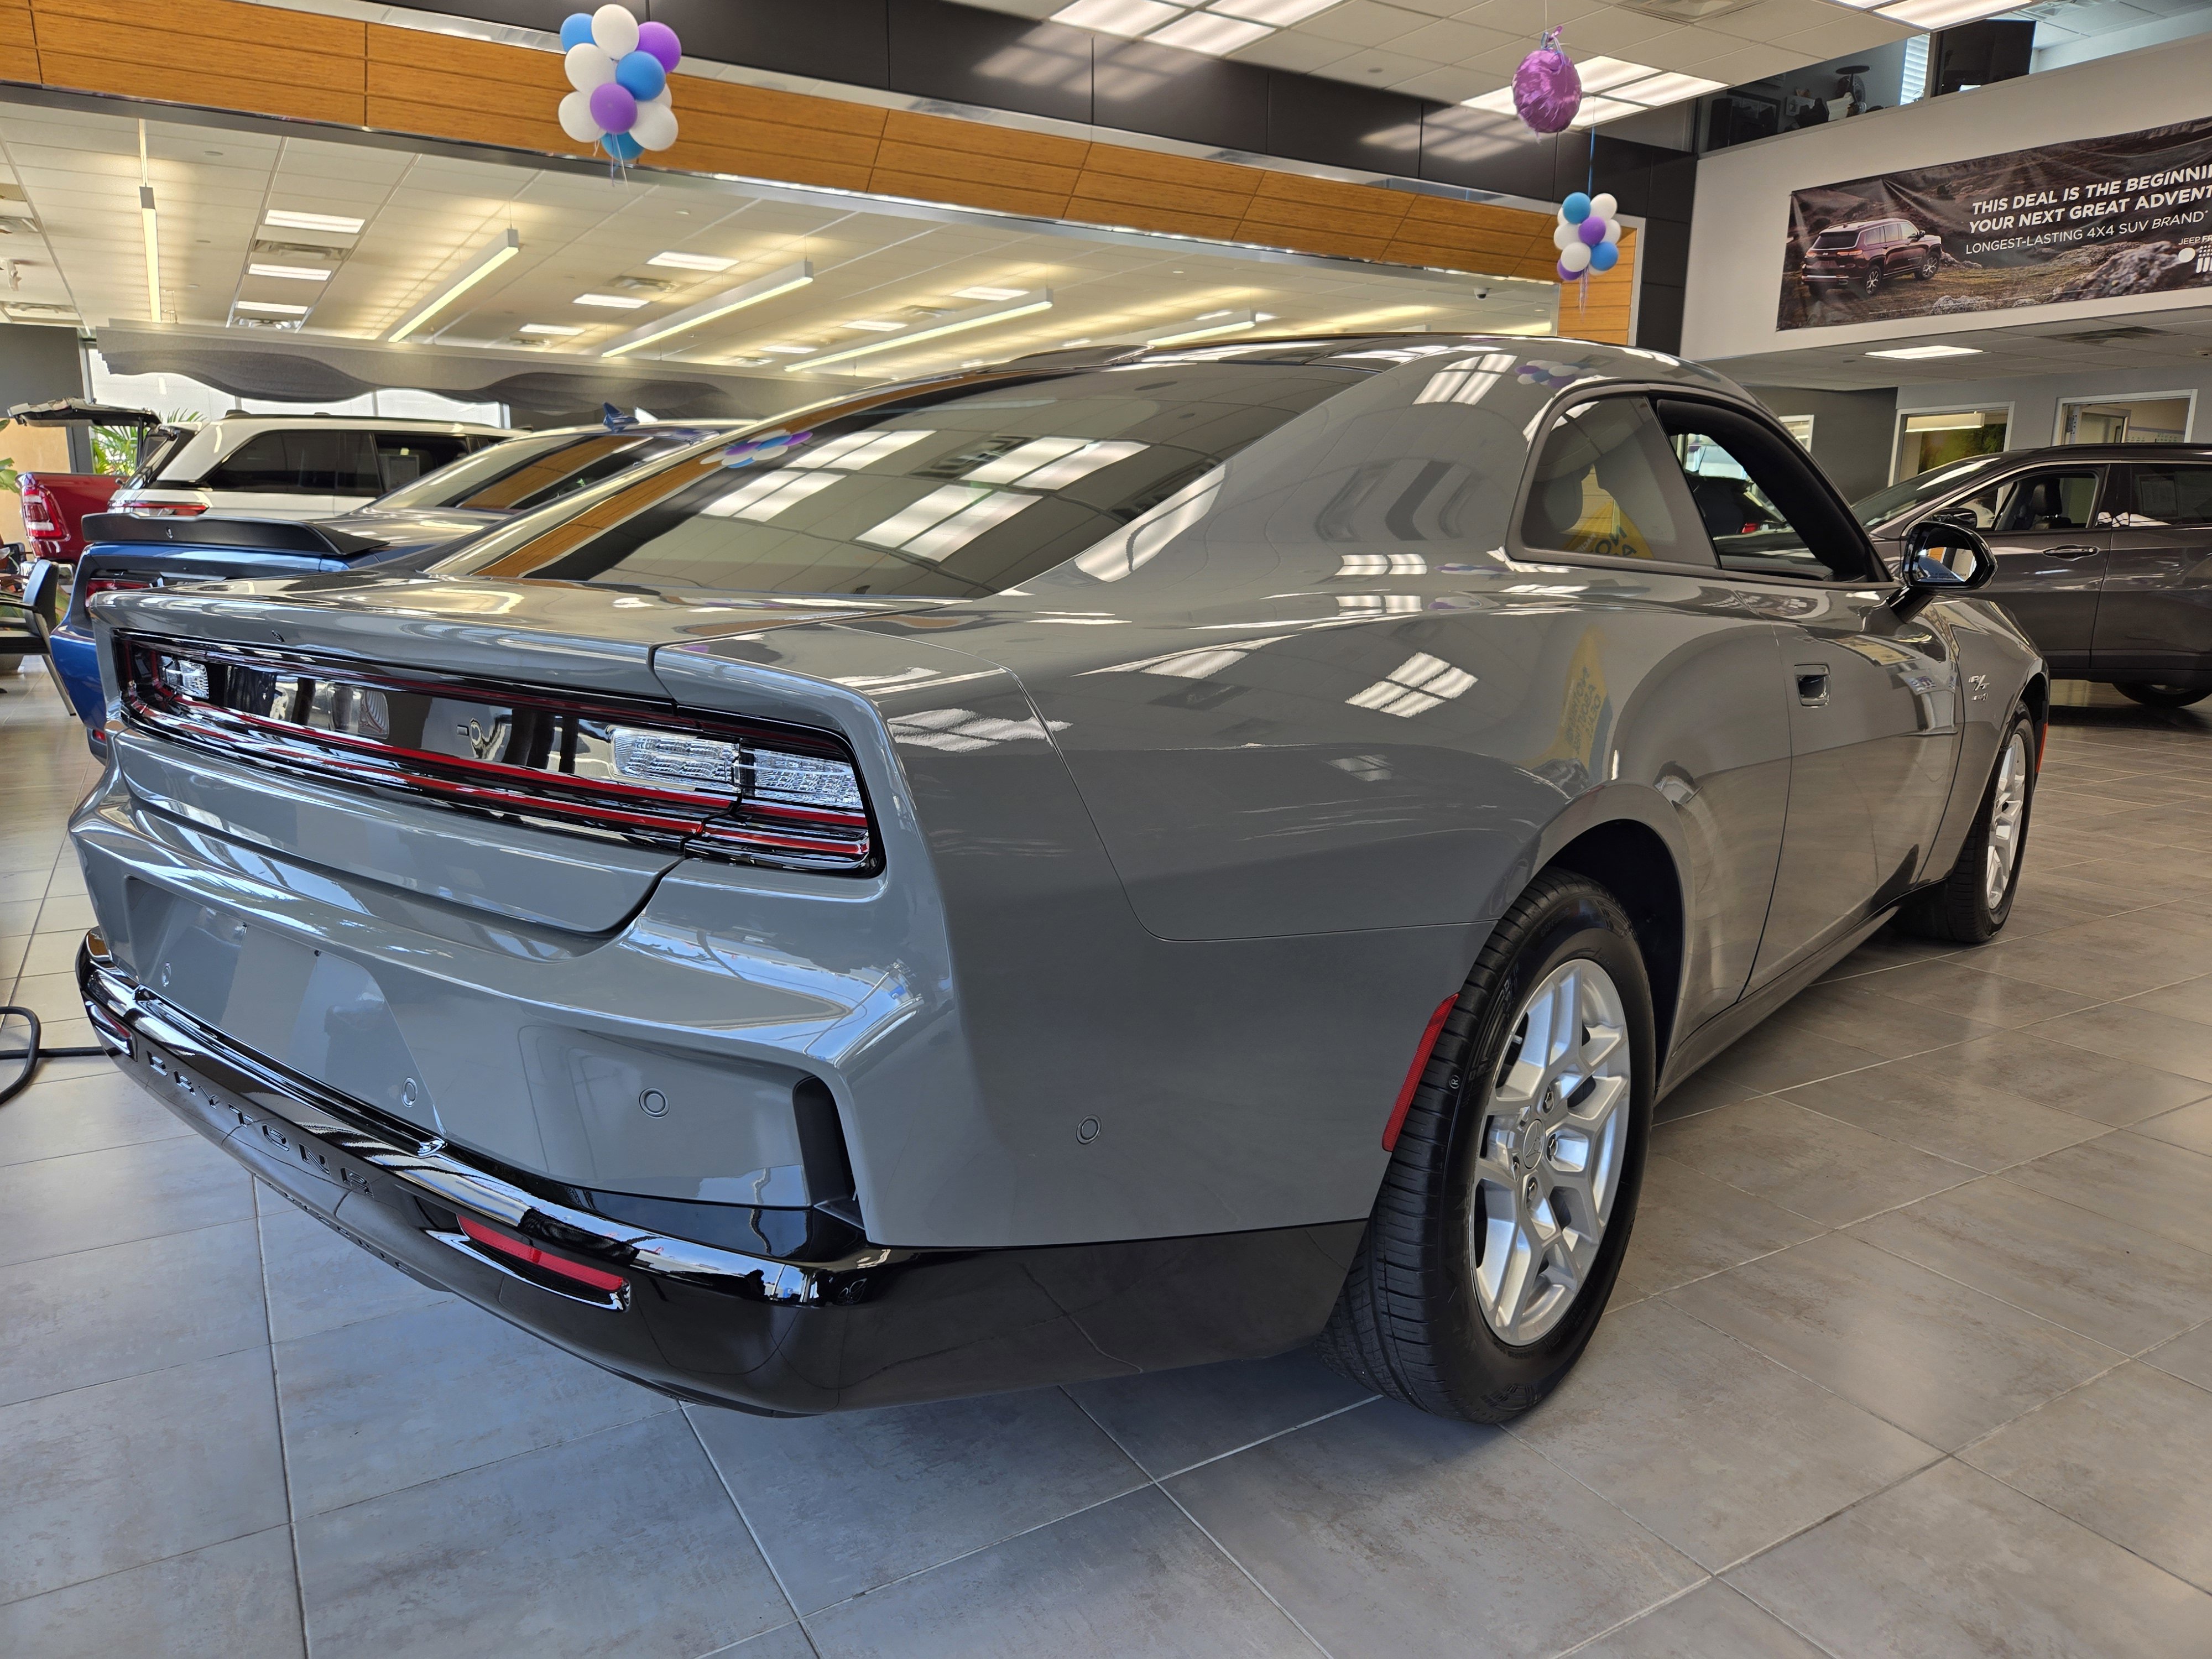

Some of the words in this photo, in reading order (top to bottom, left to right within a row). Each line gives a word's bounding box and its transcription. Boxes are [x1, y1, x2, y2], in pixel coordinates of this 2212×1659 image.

[1972, 198, 2008, 215] THIS
[2012, 190, 2058, 209] DEAL
[2063, 187, 2080, 202] IS
[2085, 180, 2121, 199] THE
[1969, 216, 2015, 234] YOUR
[2018, 208, 2065, 227] NEXT
[2069, 197, 2131, 220] GREAT
[1966, 229, 2083, 254] LONGEST-LASTING
[2086, 225, 2115, 238] 4X4
[2119, 220, 2149, 234] SUV
[2178, 236, 2201, 245] JEEP
[146, 1050, 375, 1198] DAYTONA
